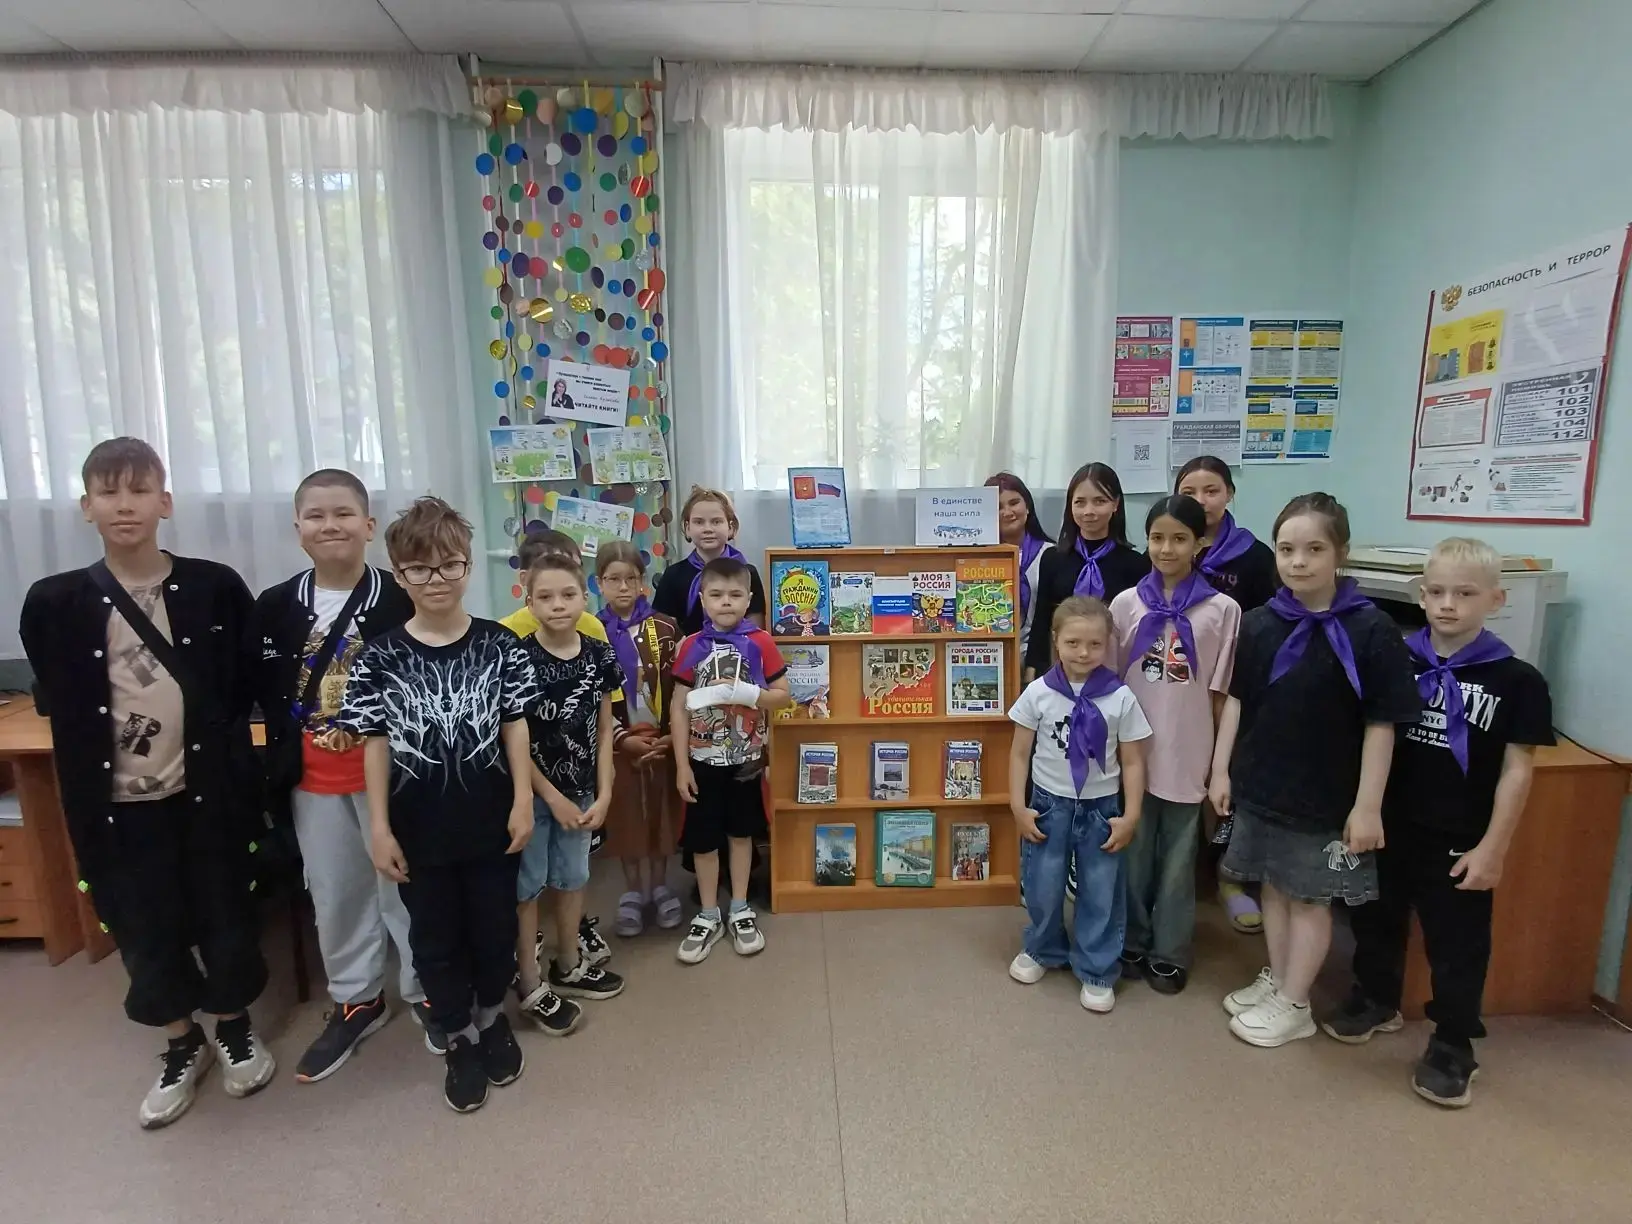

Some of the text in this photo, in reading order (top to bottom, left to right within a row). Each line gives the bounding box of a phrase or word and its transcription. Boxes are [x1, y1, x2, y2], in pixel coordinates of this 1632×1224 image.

[1467, 245, 1611, 297] БЕЗОПАСНОСТЬ И ТЕРРОР
[1558, 384, 1589, 395] 101
[1556, 396, 1589, 406] 102
[1555, 407, 1588, 417] 103
[1552, 418, 1586, 428] 104
[1551, 429, 1584, 439] 112
[932, 497, 983, 505] В единстве
[963, 567, 1005, 578] РОССИЯ
[797, 578, 805, 586] Я
[913, 581, 951, 589] РОССИЯ
[782, 585, 819, 595] ГРАЖДАНИН
[784, 592, 816, 605] РОССИИ
[868, 697, 934, 715] Россия
[1424, 714, 1442, 725] NYC
